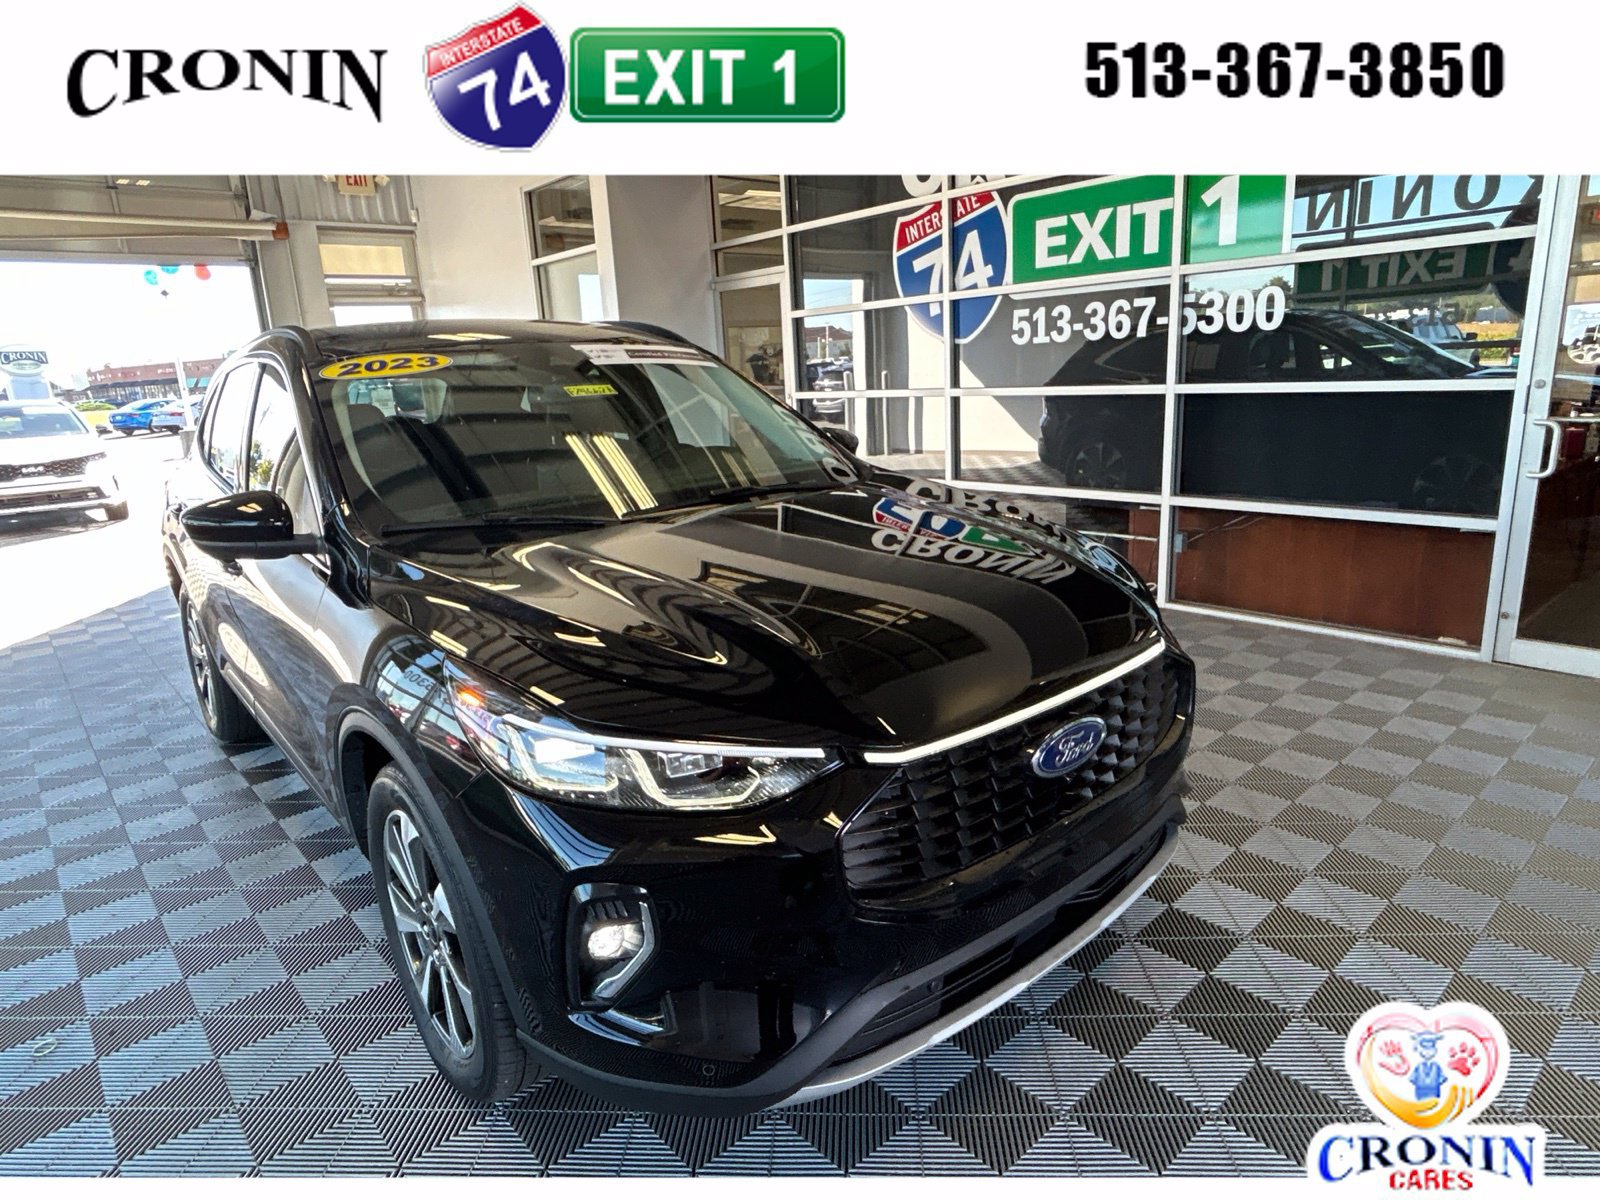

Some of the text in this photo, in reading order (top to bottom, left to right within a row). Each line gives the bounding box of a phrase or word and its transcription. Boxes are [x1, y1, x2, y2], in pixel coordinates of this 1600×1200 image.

[904, 195, 981, 245] INTERATE
[1035, 175, 1241, 270] EXIT 1
[912, 229, 995, 317] 74
[1, 352, 47, 364] CRONIN
[338, 356, 441, 376] 2023
[1055, 730, 1094, 768] Ford
